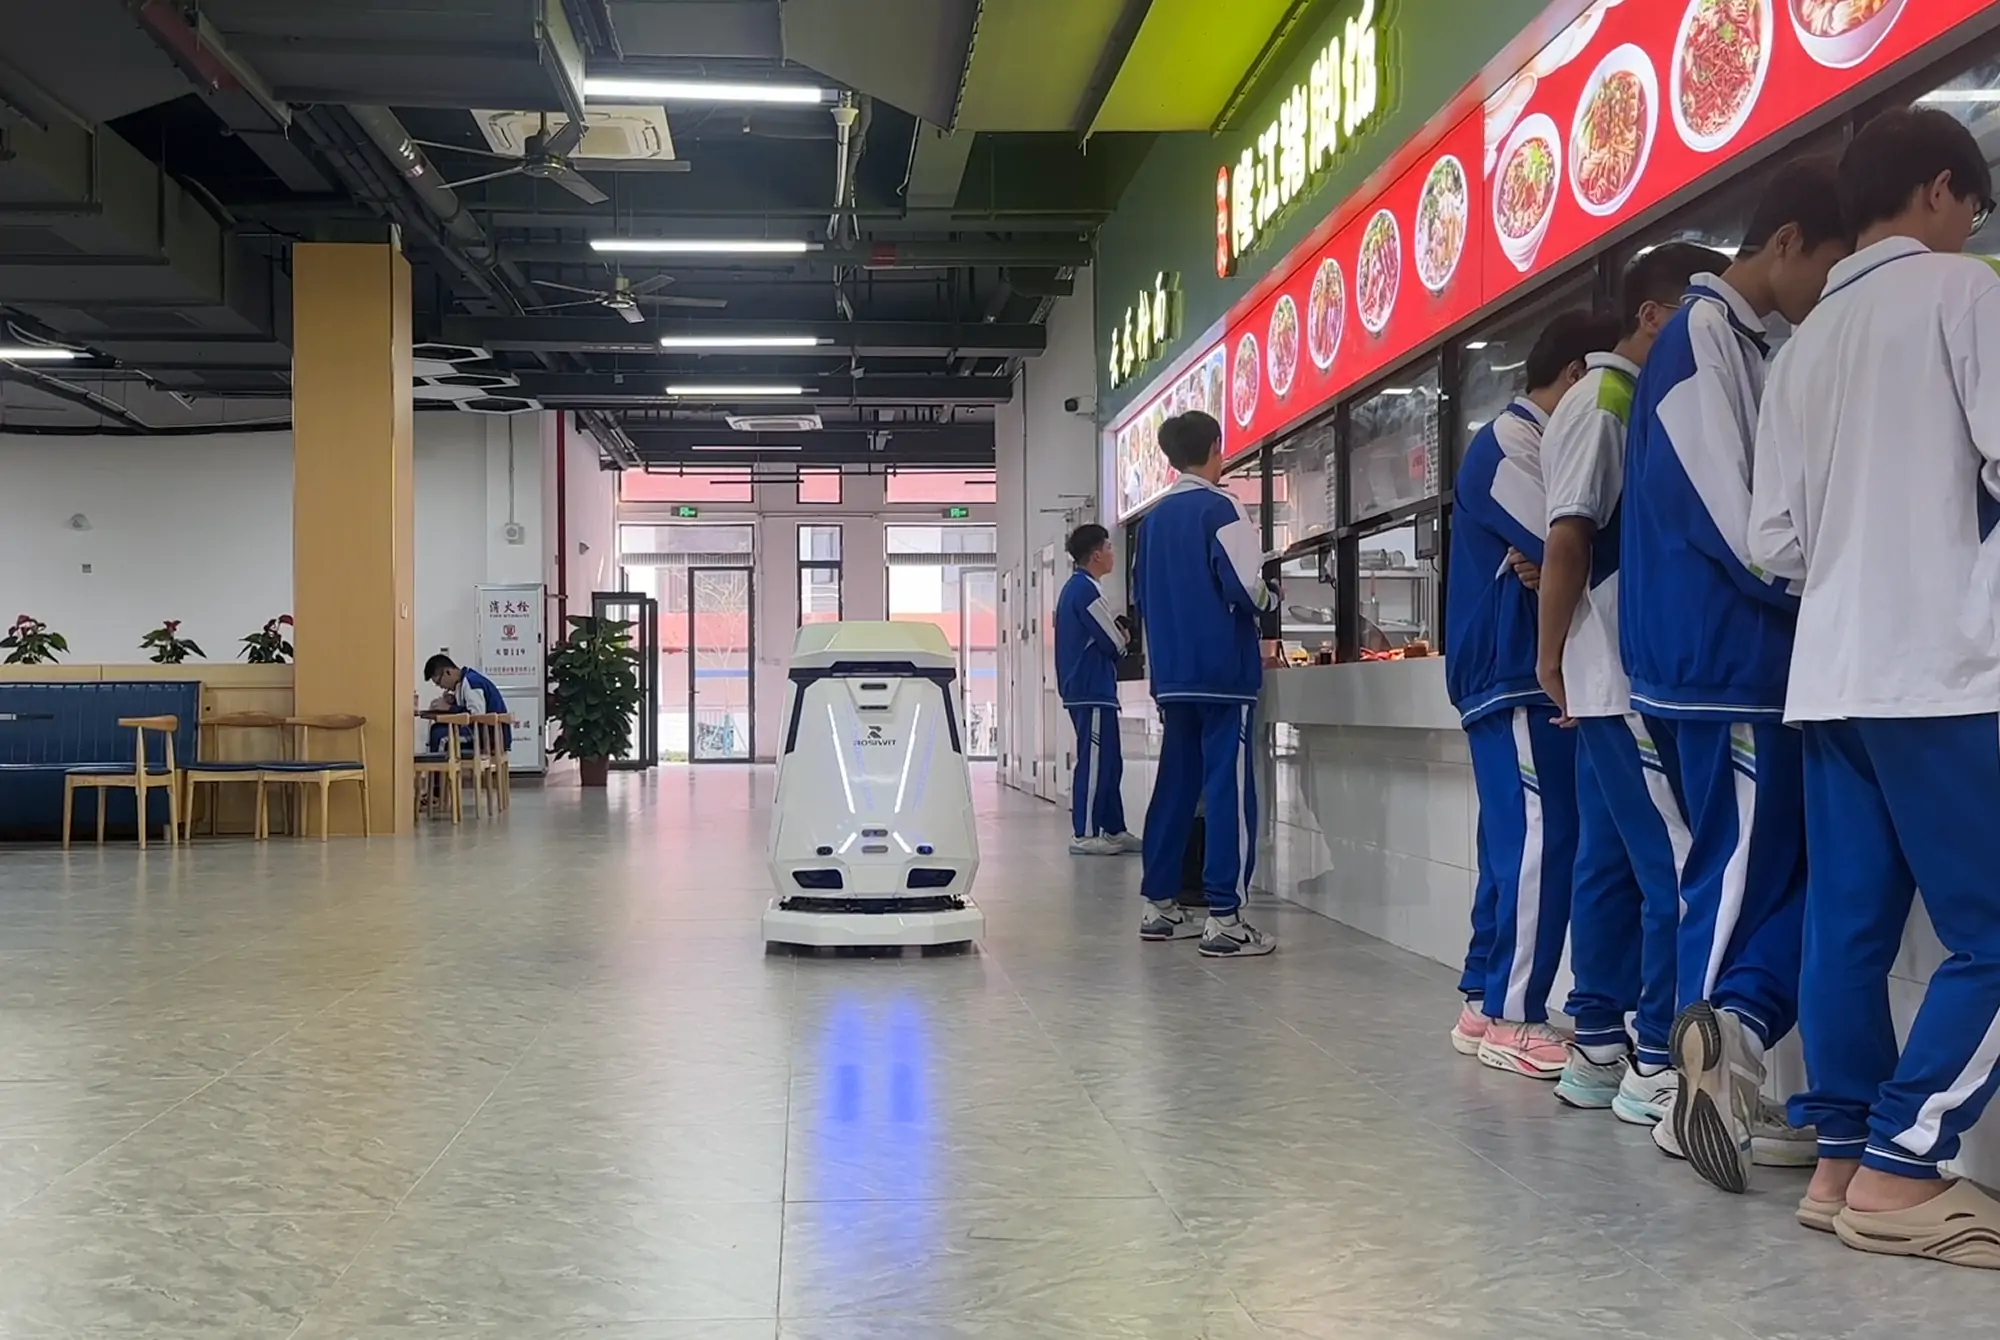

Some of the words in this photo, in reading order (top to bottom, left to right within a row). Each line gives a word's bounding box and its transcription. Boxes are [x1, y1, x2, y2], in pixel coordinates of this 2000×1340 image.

[1232, 0, 1376, 259] 隆江猪脚饭
[489, 600, 530, 613] 消火栓
